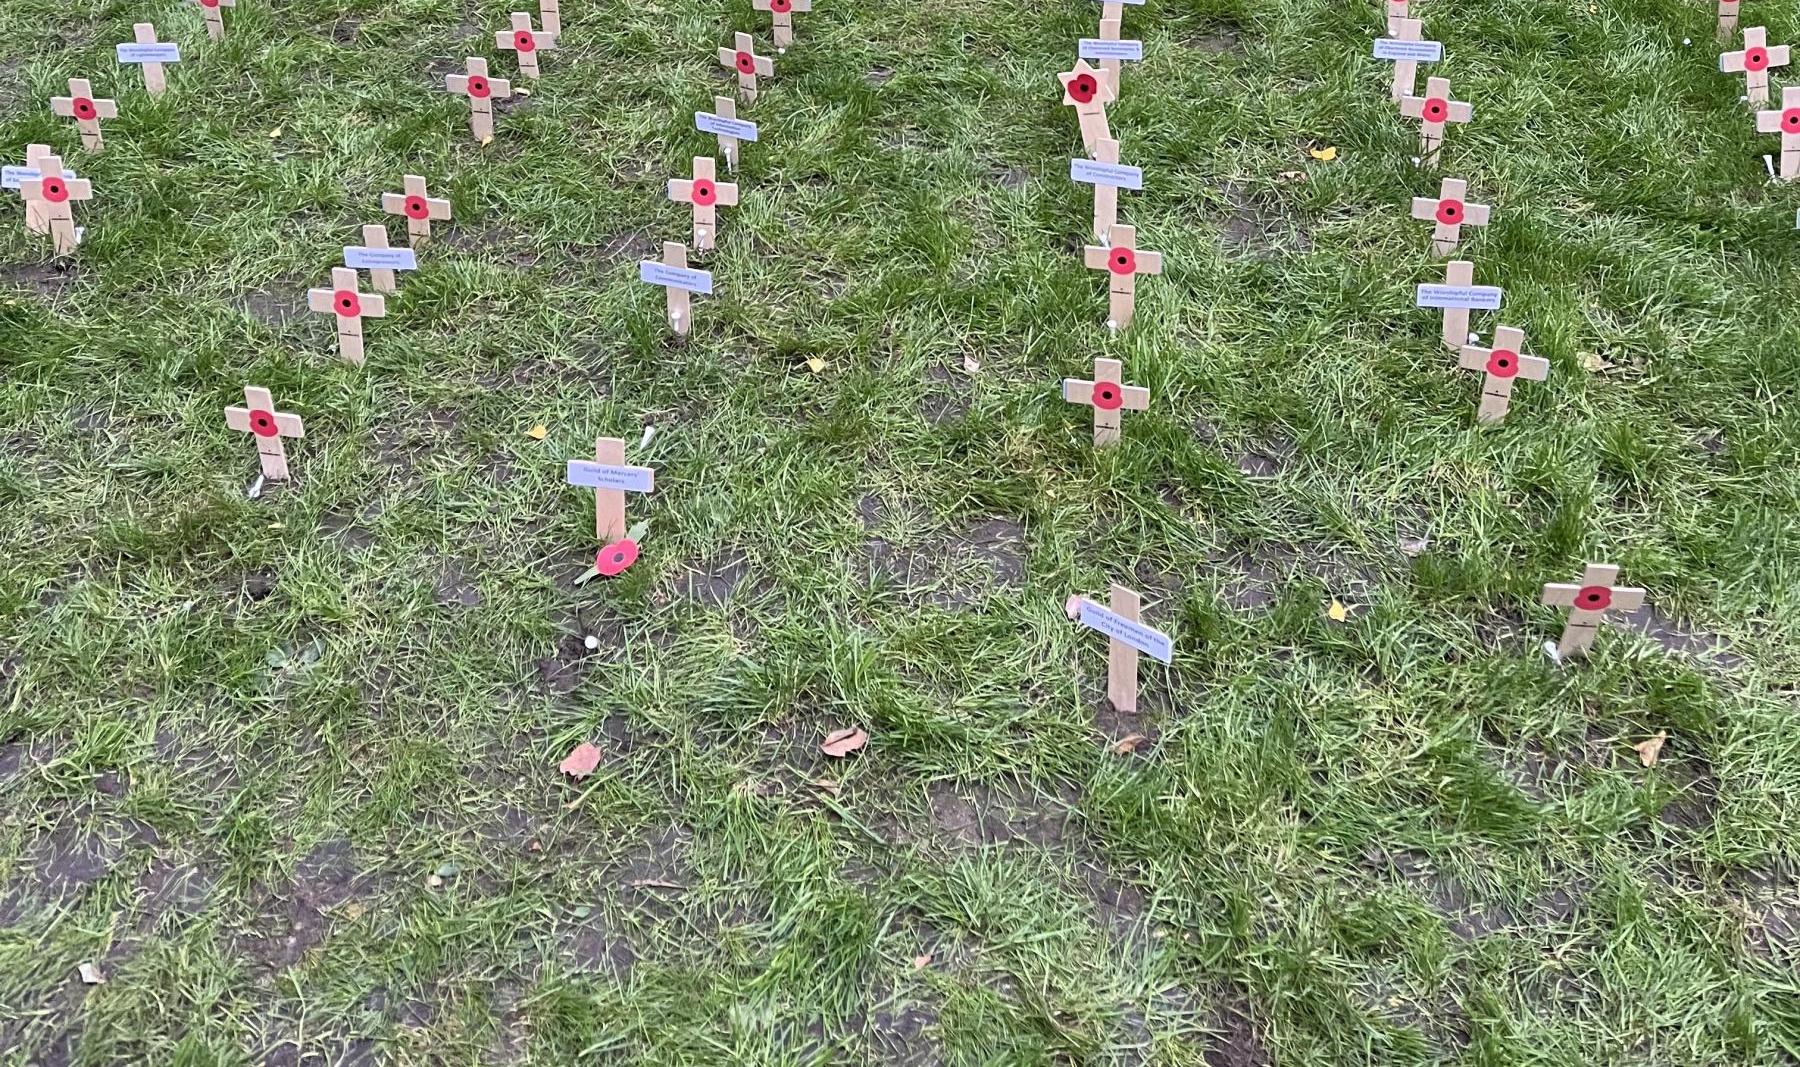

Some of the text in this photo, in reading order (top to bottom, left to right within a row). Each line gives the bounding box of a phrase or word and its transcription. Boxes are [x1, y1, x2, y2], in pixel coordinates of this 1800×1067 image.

[1114, 168, 1139, 178] Company
[665, 269, 690, 280] Company
[1086, 606, 1104, 618] Guild
[1114, 618, 1144, 636] Freemen
[1154, 637, 1165, 646] the
[1101, 621, 1114, 632] City
[1124, 631, 1150, 648] London
